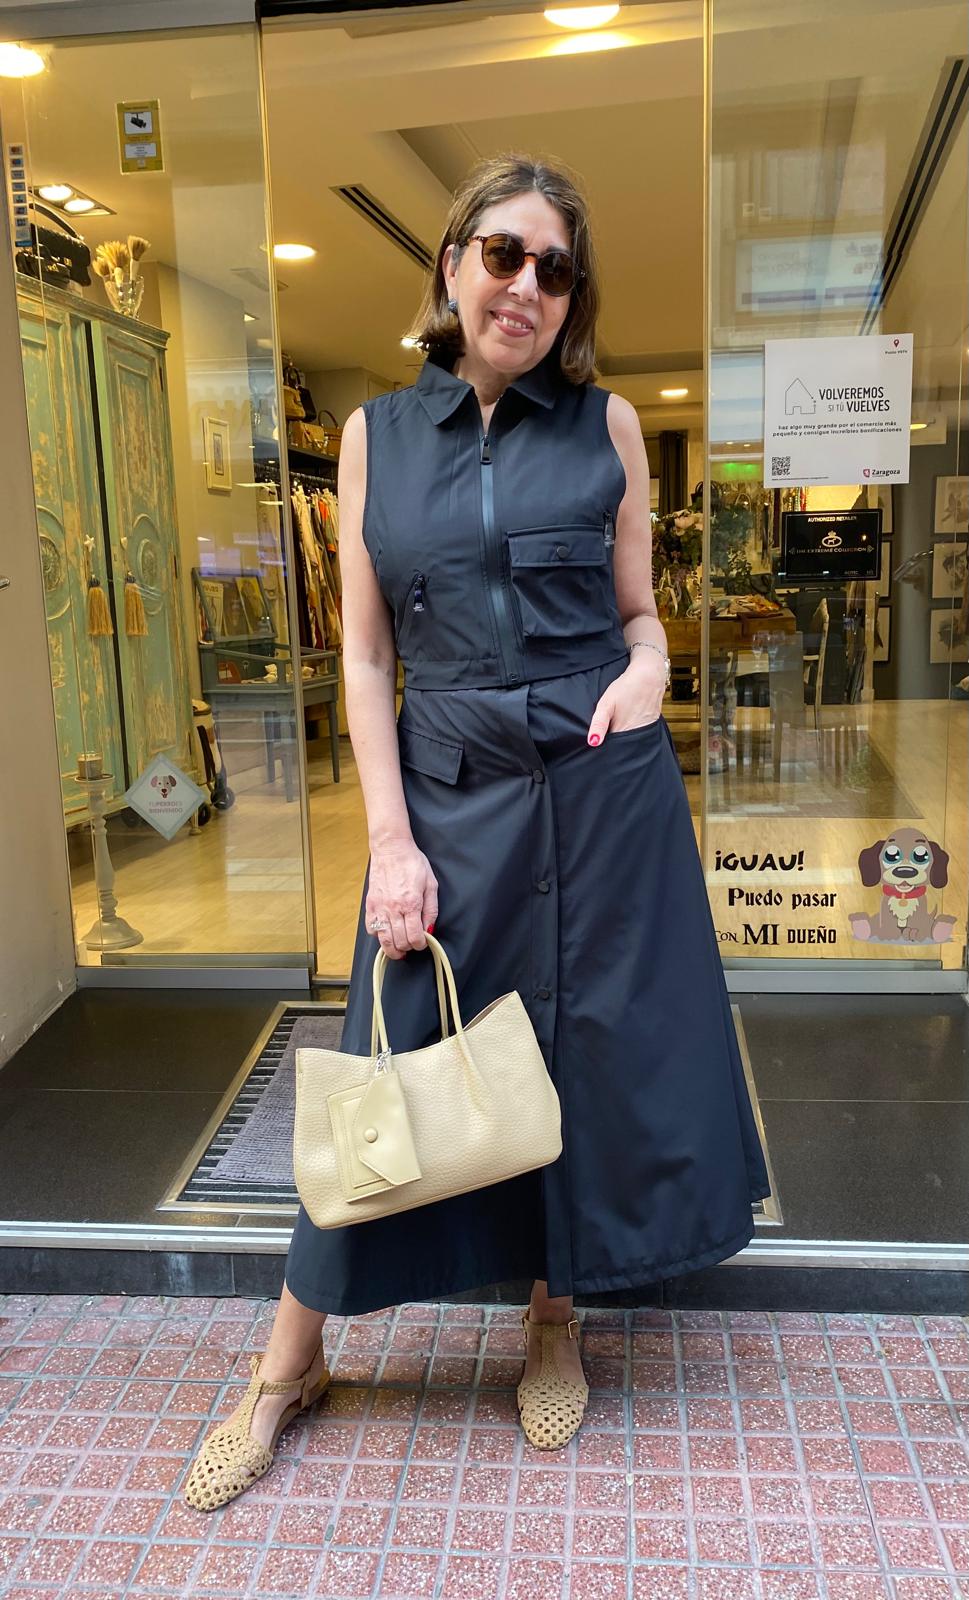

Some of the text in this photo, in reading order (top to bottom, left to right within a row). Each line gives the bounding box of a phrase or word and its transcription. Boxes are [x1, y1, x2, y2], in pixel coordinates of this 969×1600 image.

[818, 386, 884, 400] VOLVEREMOS
[828, 399, 890, 413] SI TÚ VUELVES
[871, 469, 901, 477] Zaragoza
[715, 850, 804, 871] ¡GUAU!
[728, 888, 837, 910] Puedo pasar
[742, 923, 780, 945] MI
[787, 925, 837, 944] DUEÑO
